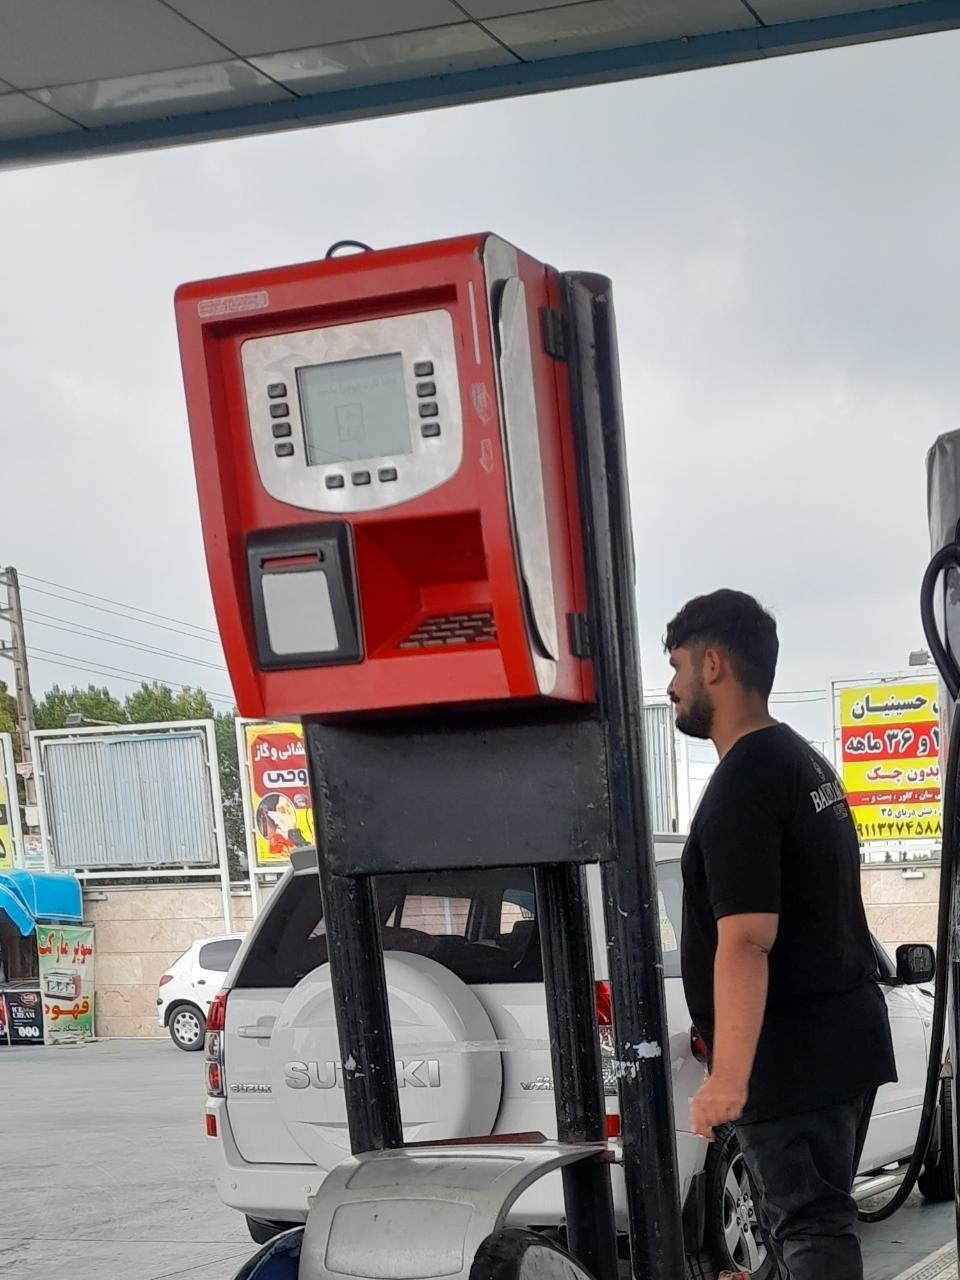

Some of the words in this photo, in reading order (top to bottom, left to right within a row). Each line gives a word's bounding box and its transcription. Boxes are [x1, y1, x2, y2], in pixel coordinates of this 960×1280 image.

[851, 695, 928, 720] حسینیان
[278, 741, 306, 760] شانی
[846, 734, 882, 753] ماهه
[885, 729, 913, 753] ۳۶
[254, 741, 270, 762] گاز
[270, 747, 277, 761] و
[267, 770, 307, 785] وحی
[866, 766, 903, 785] چک
[857, 820, 942, 837] ۹۱۱۳۲۷۴۵۸۸
[284, 1058, 441, 1090] SUKI
[520, 1081, 554, 1091] VITA
